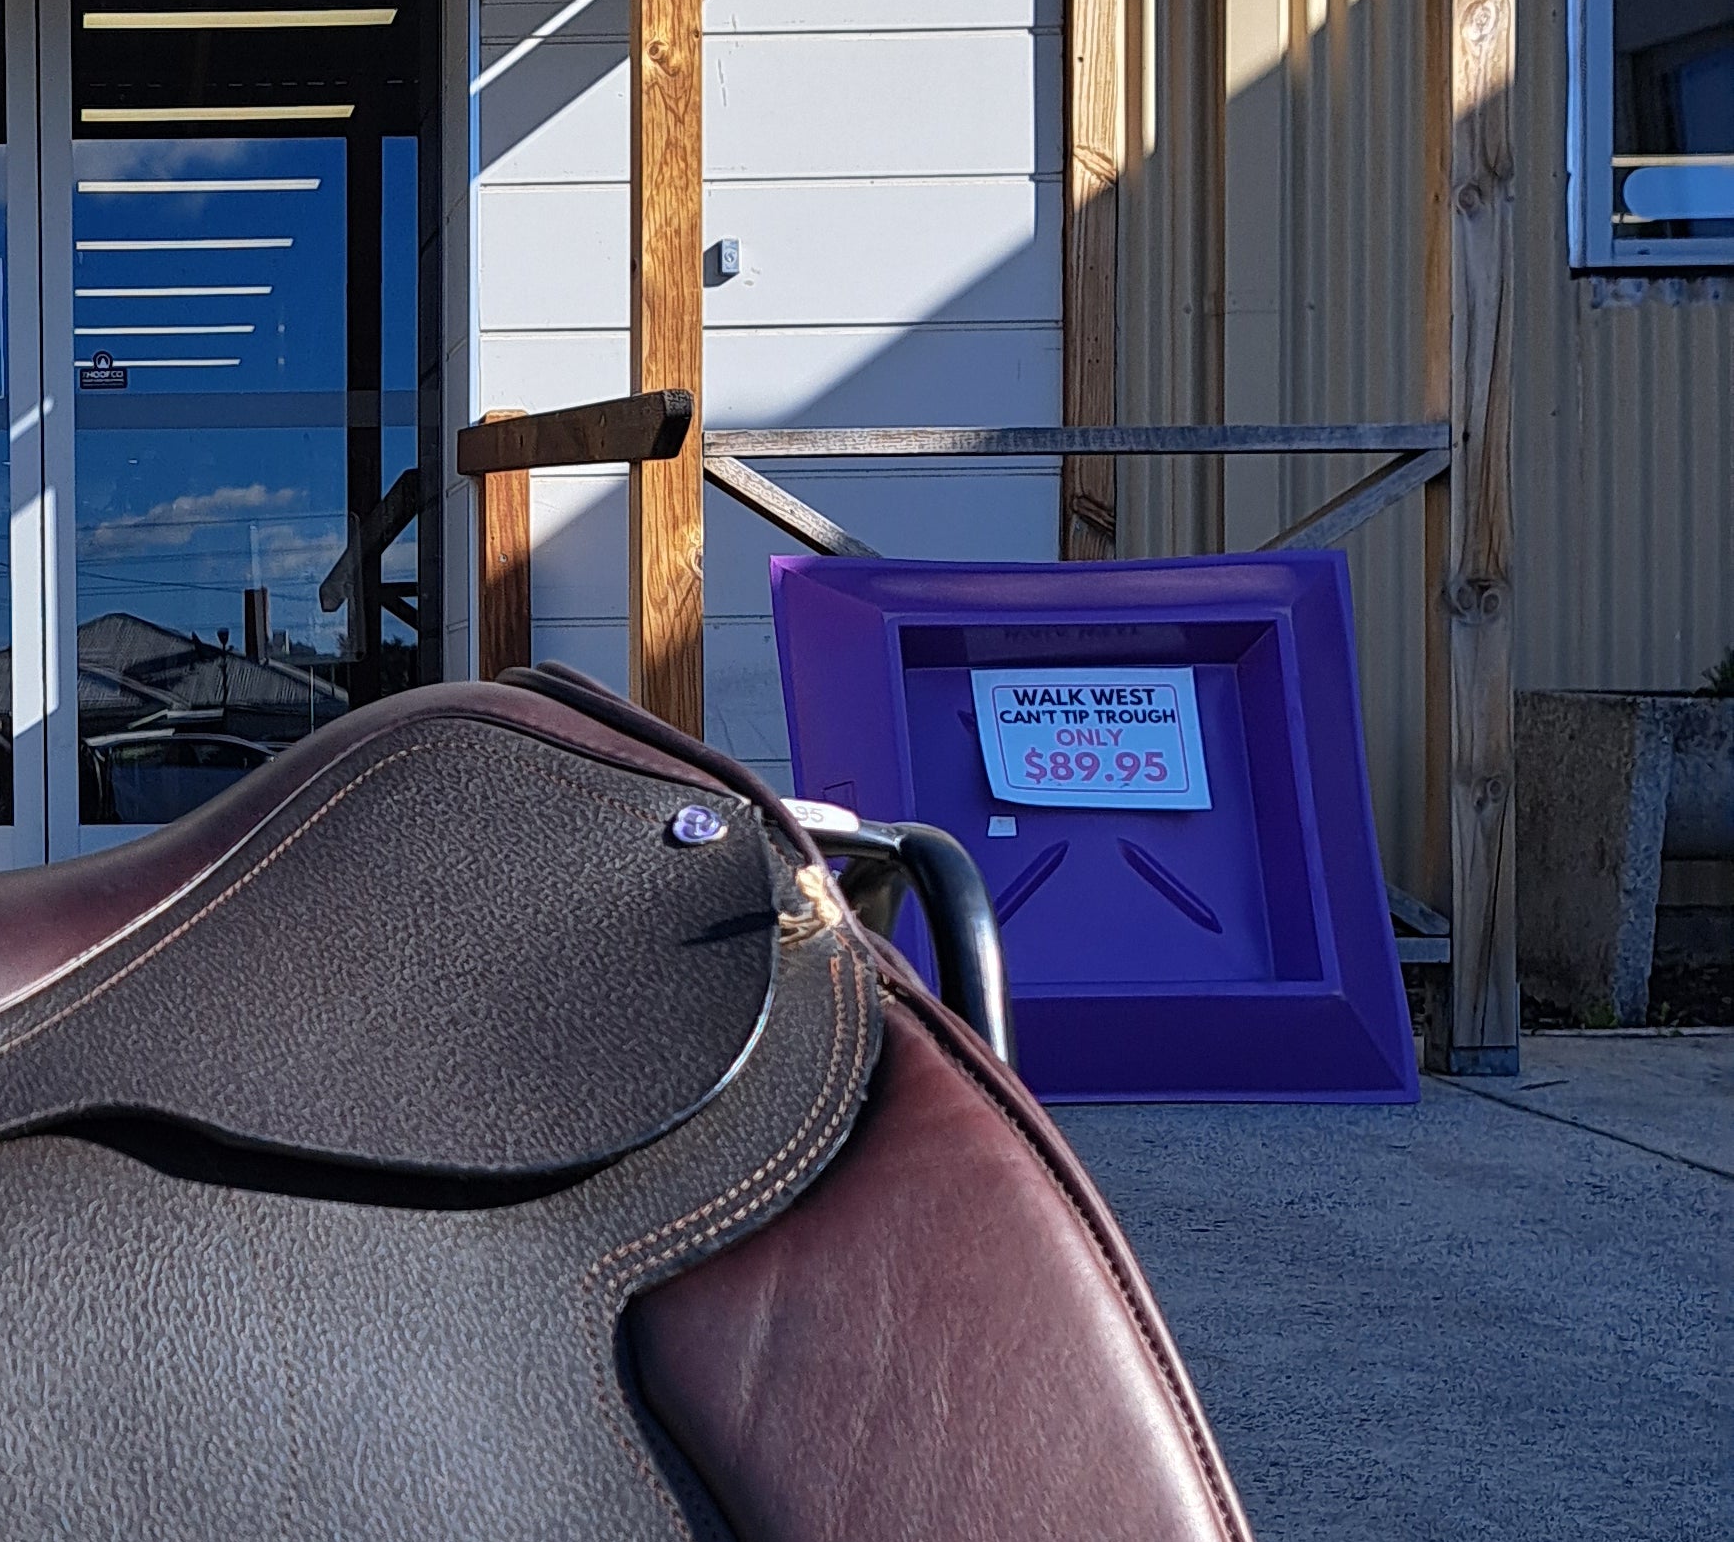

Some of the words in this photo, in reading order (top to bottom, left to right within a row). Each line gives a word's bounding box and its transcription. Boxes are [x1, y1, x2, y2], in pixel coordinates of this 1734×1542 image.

[1012, 688, 1086, 706] WALK
[1090, 688, 1155, 706] WEST
[999, 709, 1056, 724] CAN'T
[1062, 709, 1090, 724] TIP
[1096, 709, 1177, 724] TROUGH
[1055, 728, 1123, 746] ONLY
[1024, 746, 1167, 785] $89.95
